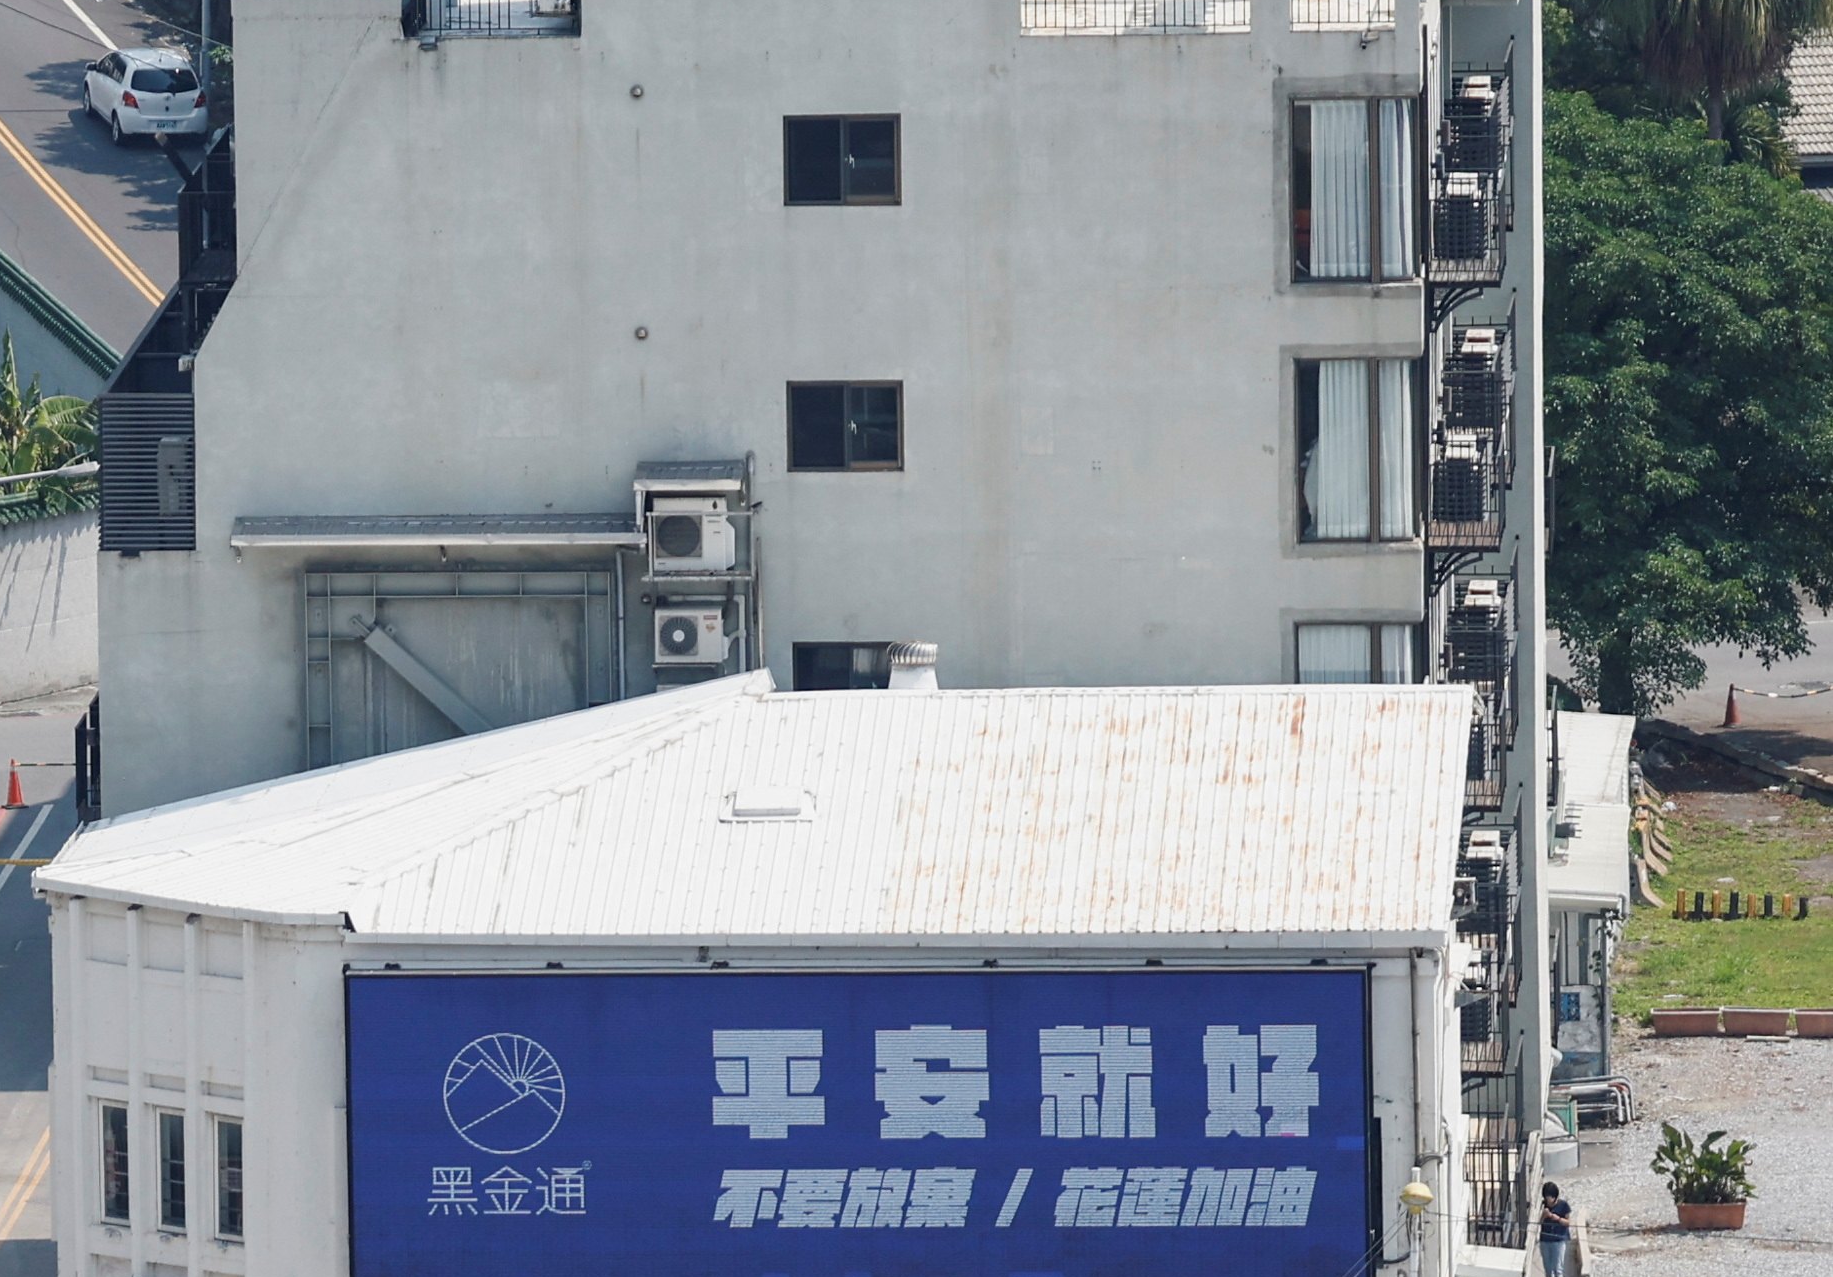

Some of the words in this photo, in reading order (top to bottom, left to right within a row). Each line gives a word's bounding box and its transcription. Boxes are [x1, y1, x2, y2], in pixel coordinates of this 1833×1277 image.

[712, 1023, 1319, 1140] 平安就好
[426, 1165, 587, 1216] 黑金通
[713, 1167, 978, 1229] 不要放棄
[1051, 1167, 1318, 1229] 花蓮加油
